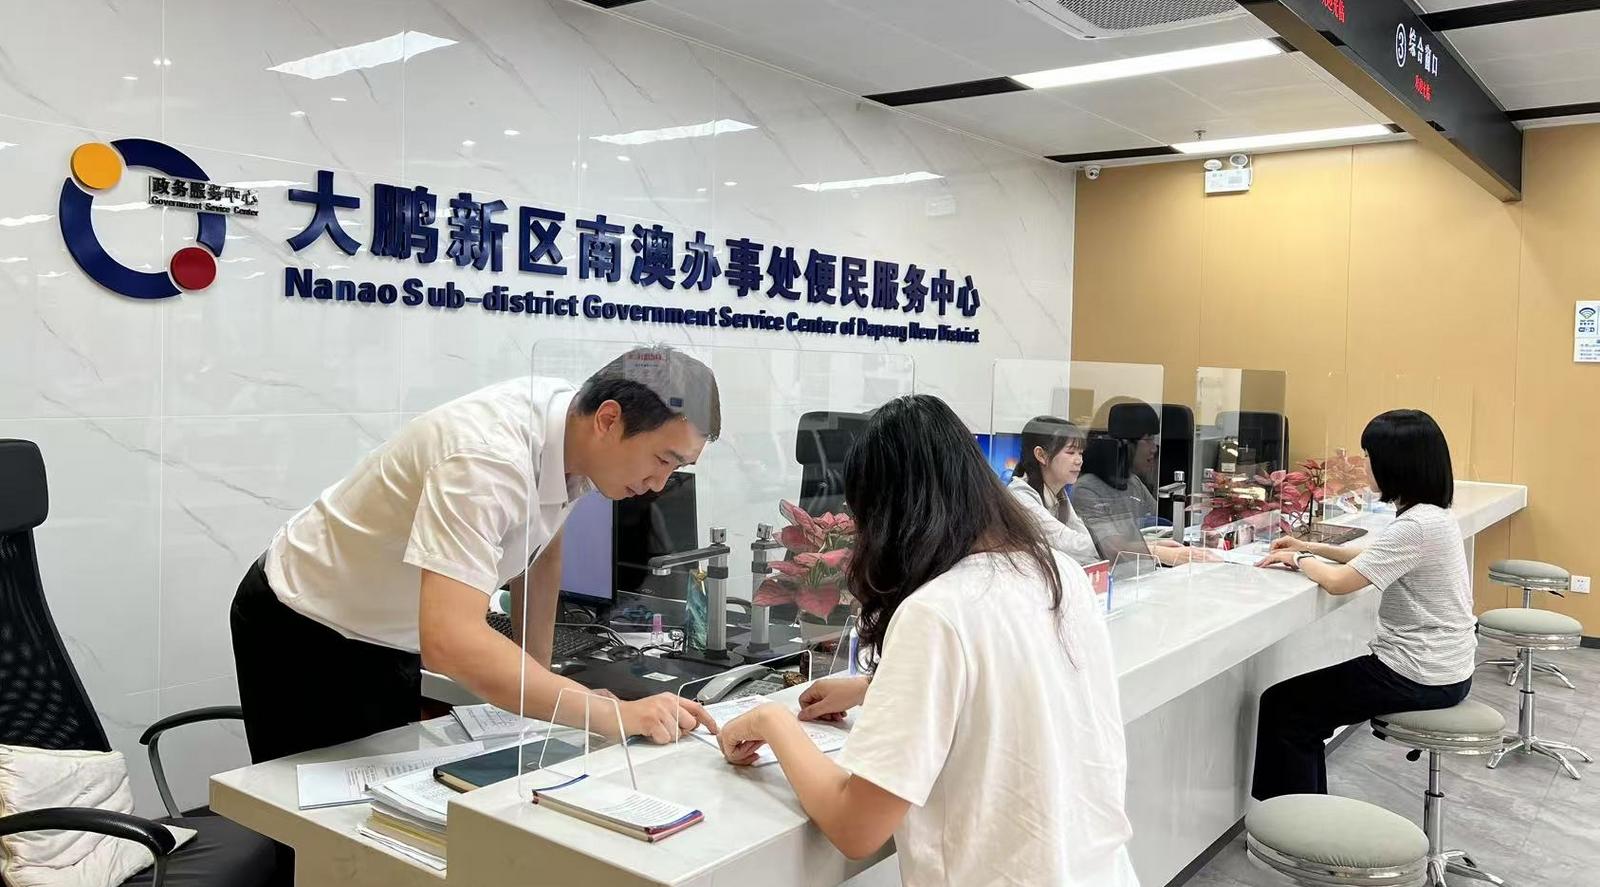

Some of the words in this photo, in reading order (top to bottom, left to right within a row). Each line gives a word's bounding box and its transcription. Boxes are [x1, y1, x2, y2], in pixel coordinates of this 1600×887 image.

[1408, 27, 1438, 77] 综合窗口
[151, 177, 258, 206] 政务服务中心
[151, 195, 202, 210] Government
[233, 206, 259, 217] Center
[286, 170, 981, 317] 大鹏新区南澳办事处便民服务中心
[284, 266, 397, 305] Nanao
[583, 294, 717, 327] Government
[718, 306, 785, 331] Service
[786, 311, 839, 334] Center
[839, 317, 856, 336] of
[857, 318, 908, 342] Dapeng
[909, 321, 937, 341] New
[937, 325, 980, 343] District
